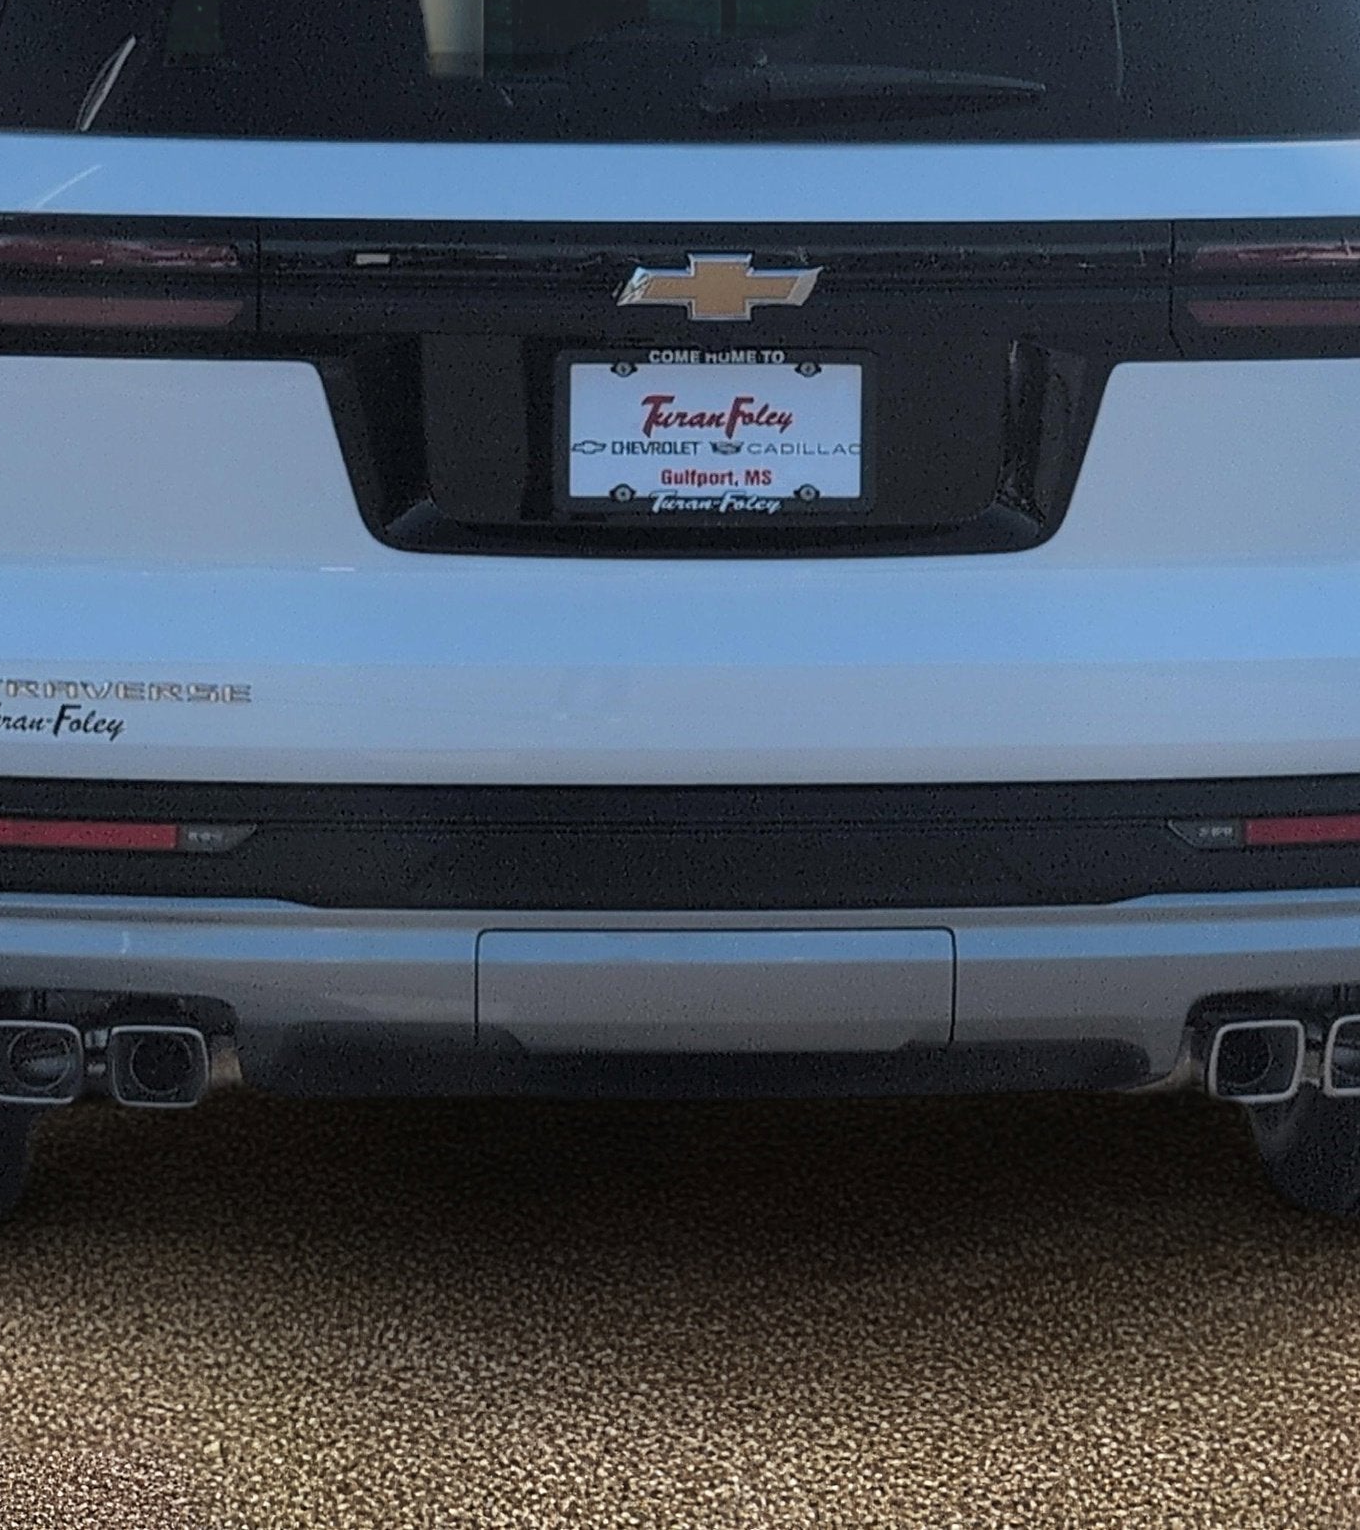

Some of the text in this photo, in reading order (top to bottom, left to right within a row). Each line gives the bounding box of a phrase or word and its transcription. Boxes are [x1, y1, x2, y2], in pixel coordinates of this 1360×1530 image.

[648, 349, 702, 364] COME
[760, 350, 785, 364] TO
[611, 441, 861, 456] CHEVROLET CADILLAC
[660, 469, 773, 488] Gulfport, MS
